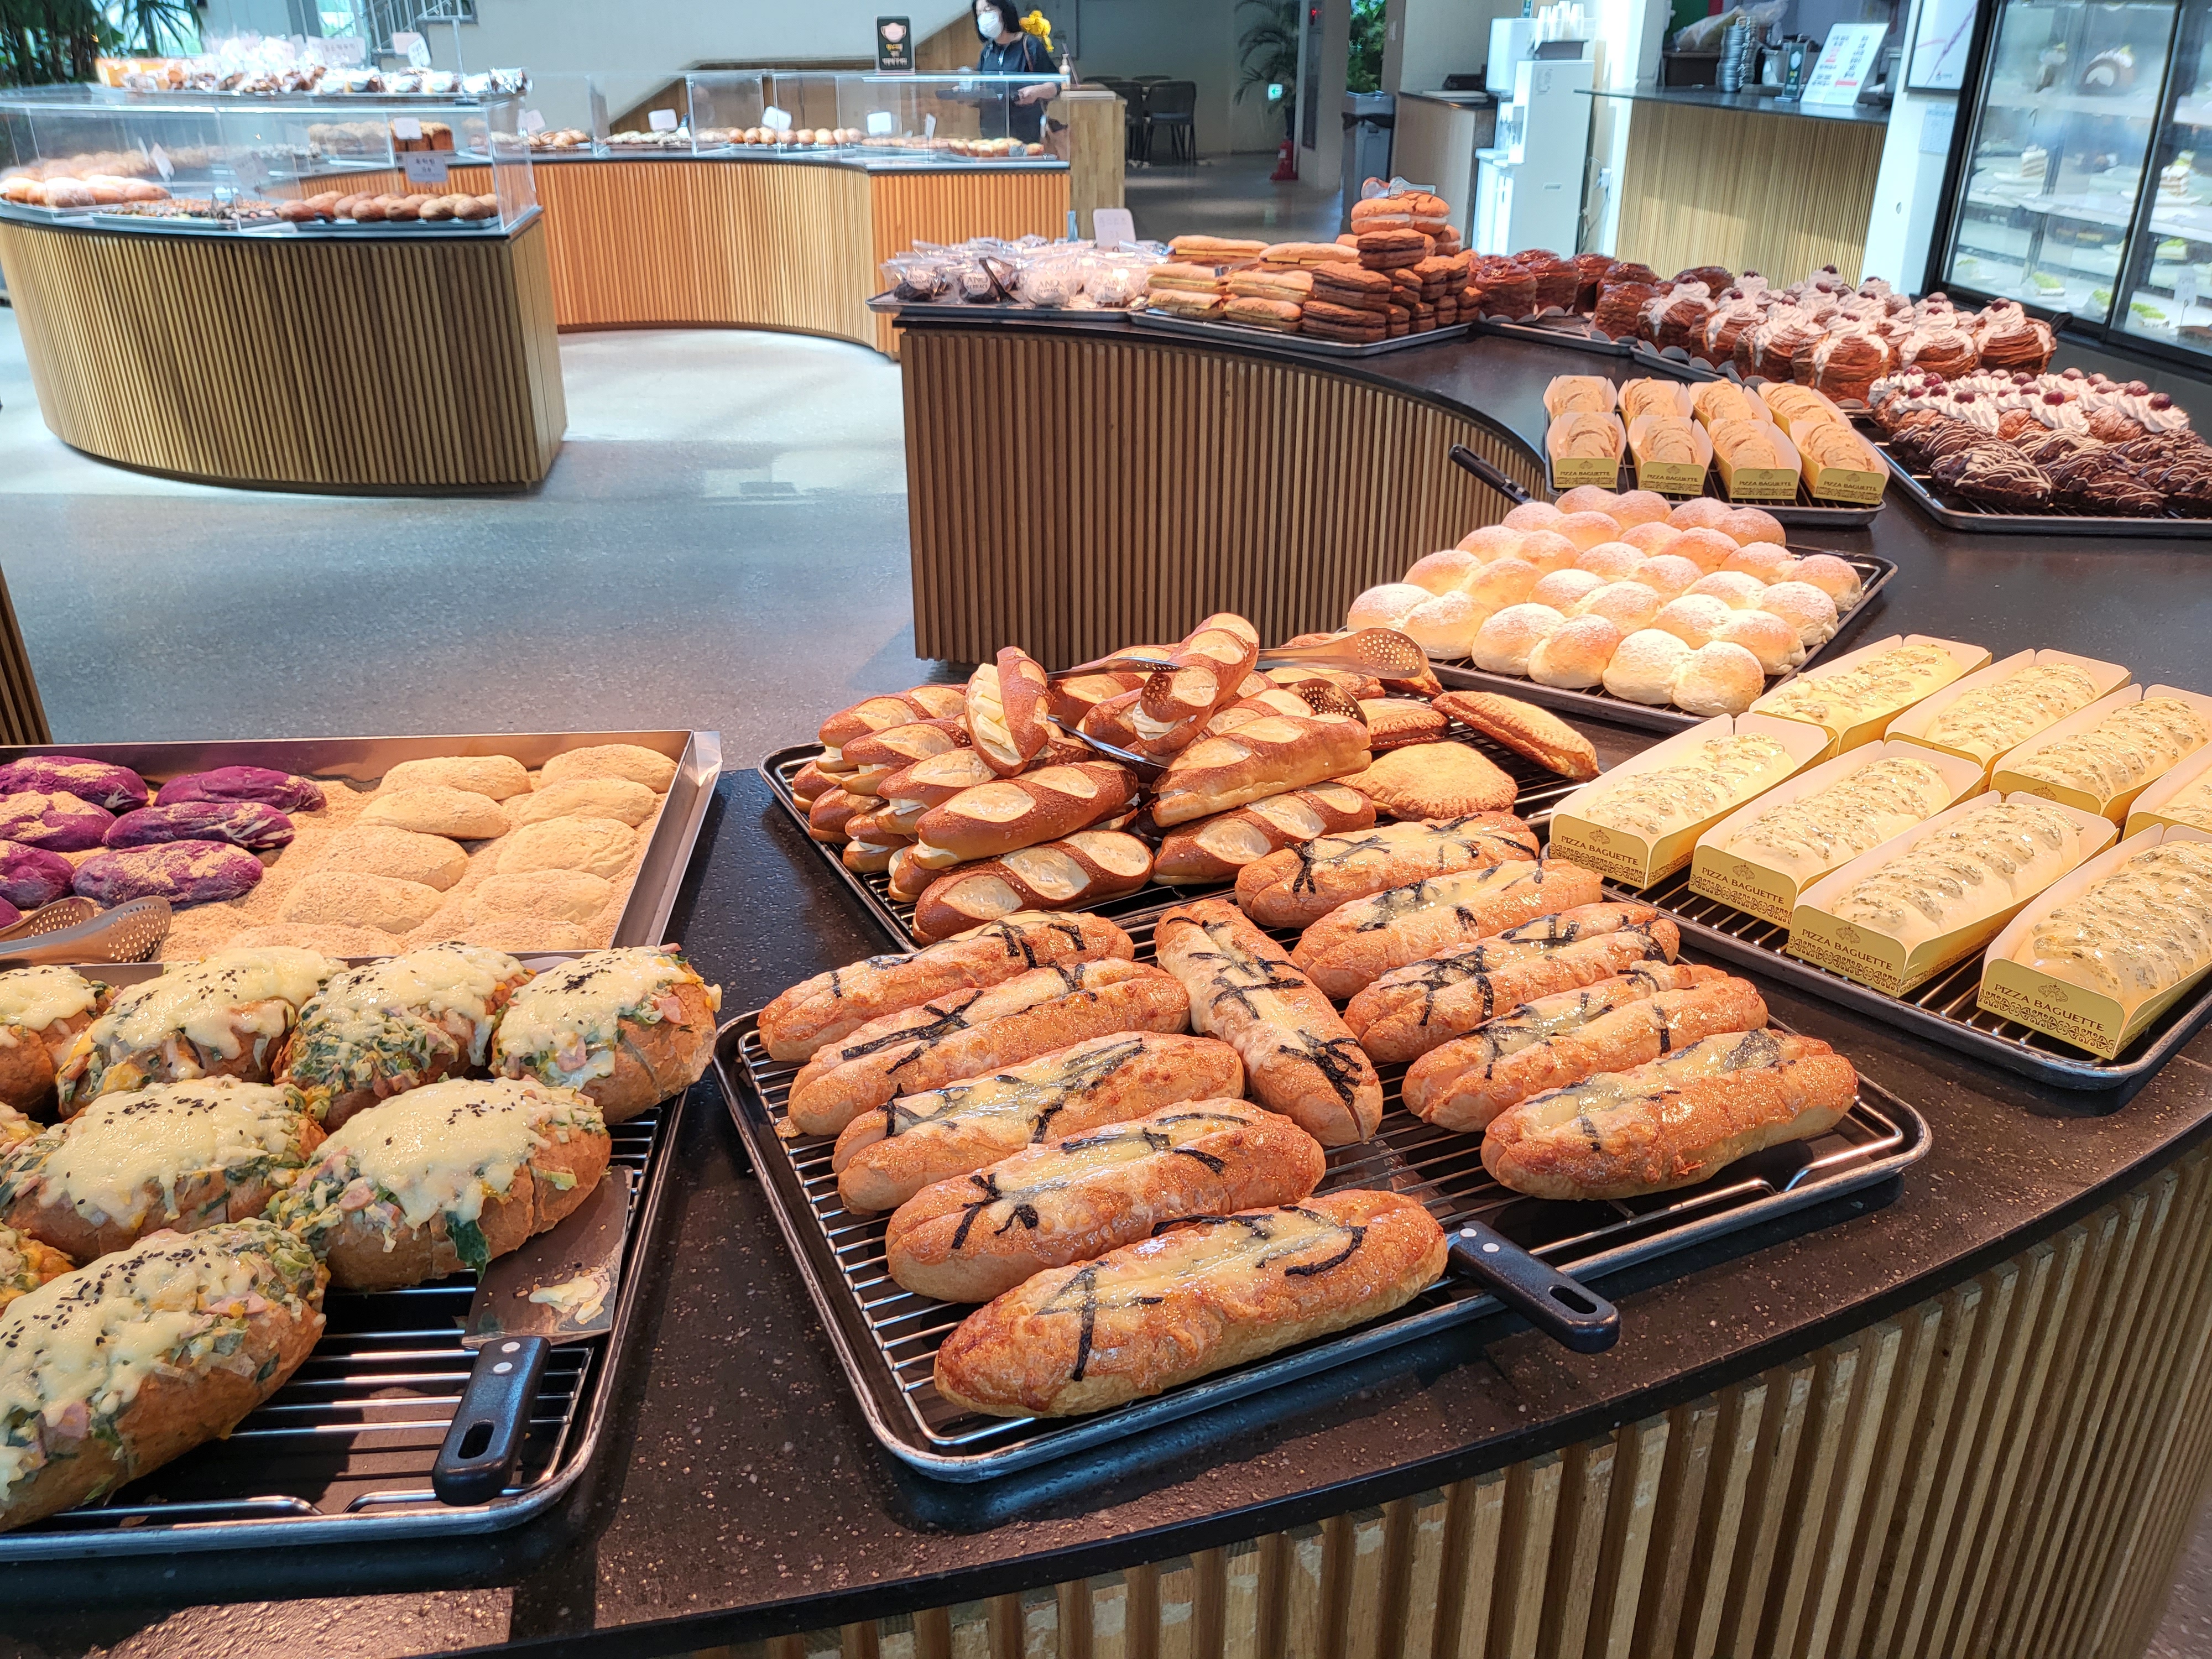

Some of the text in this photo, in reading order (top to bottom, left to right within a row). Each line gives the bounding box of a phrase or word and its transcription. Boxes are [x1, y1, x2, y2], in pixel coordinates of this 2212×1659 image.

[1037, 279, 1060, 289] AND
[1843, 483, 1877, 491] BAGUETTE
[1561, 835, 1639, 865] PIZZA BAGUETTE
[1702, 867, 1784, 904] PIZZA BAGUETTE
[1801, 928, 1893, 971] PIZZA BAGUETTE
[1994, 983, 2104, 1031] PIZZA BAGUETTE
